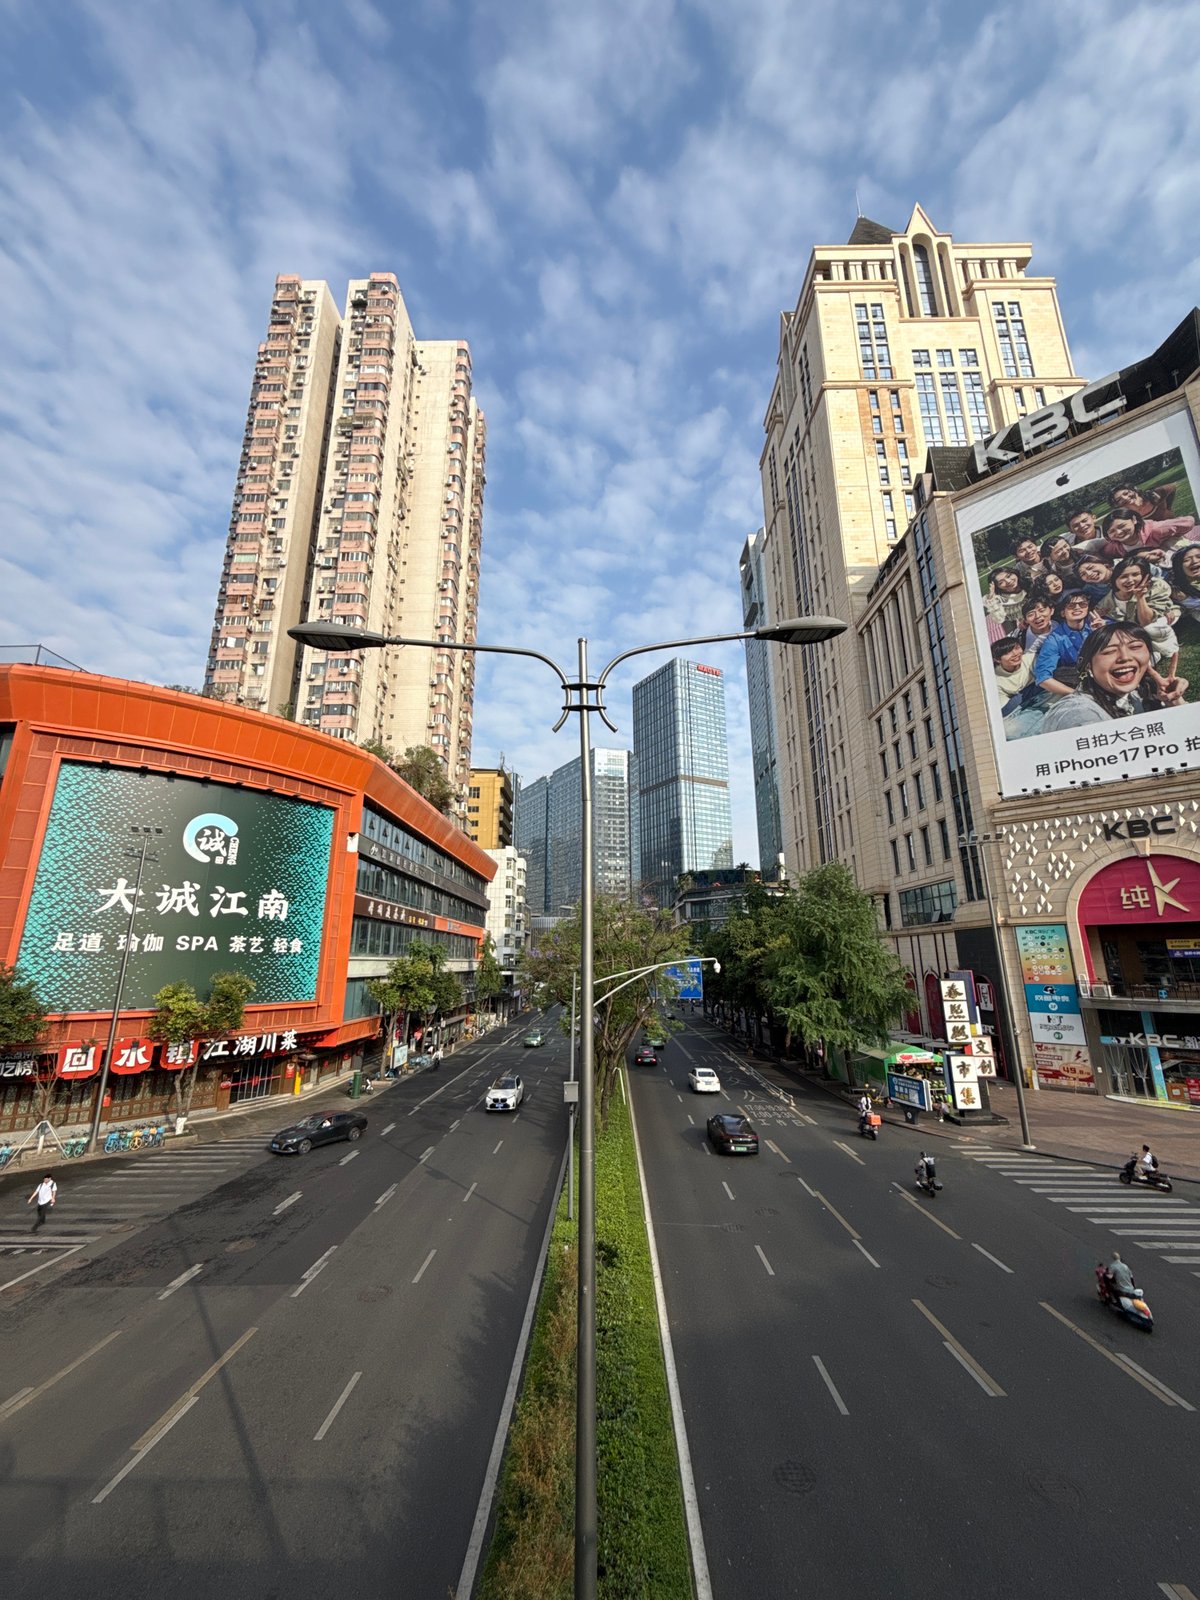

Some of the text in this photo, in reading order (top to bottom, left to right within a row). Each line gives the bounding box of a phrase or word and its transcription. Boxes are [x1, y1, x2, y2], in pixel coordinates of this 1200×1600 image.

[974, 371, 1127, 474] KBC
[1076, 722, 1166, 751] 自拍大合照
[1036, 763, 1051, 777] 用
[1144, 743, 1179, 758] Pro
[1103, 815, 1177, 841] KBC
[92, 877, 289, 921] 大诚江南
[52, 932, 102, 953] 足道
[116, 934, 164, 952] 瑜伽
[175, 936, 219, 951] SPA
[229, 936, 265, 953] 茶艺
[203, 1028, 298, 1061] 江湖川菜
[1129, 1032, 1180, 1049] KBC
[975, 1039, 993, 1075] 文创
[757, 1118, 806, 1127] 工作日
